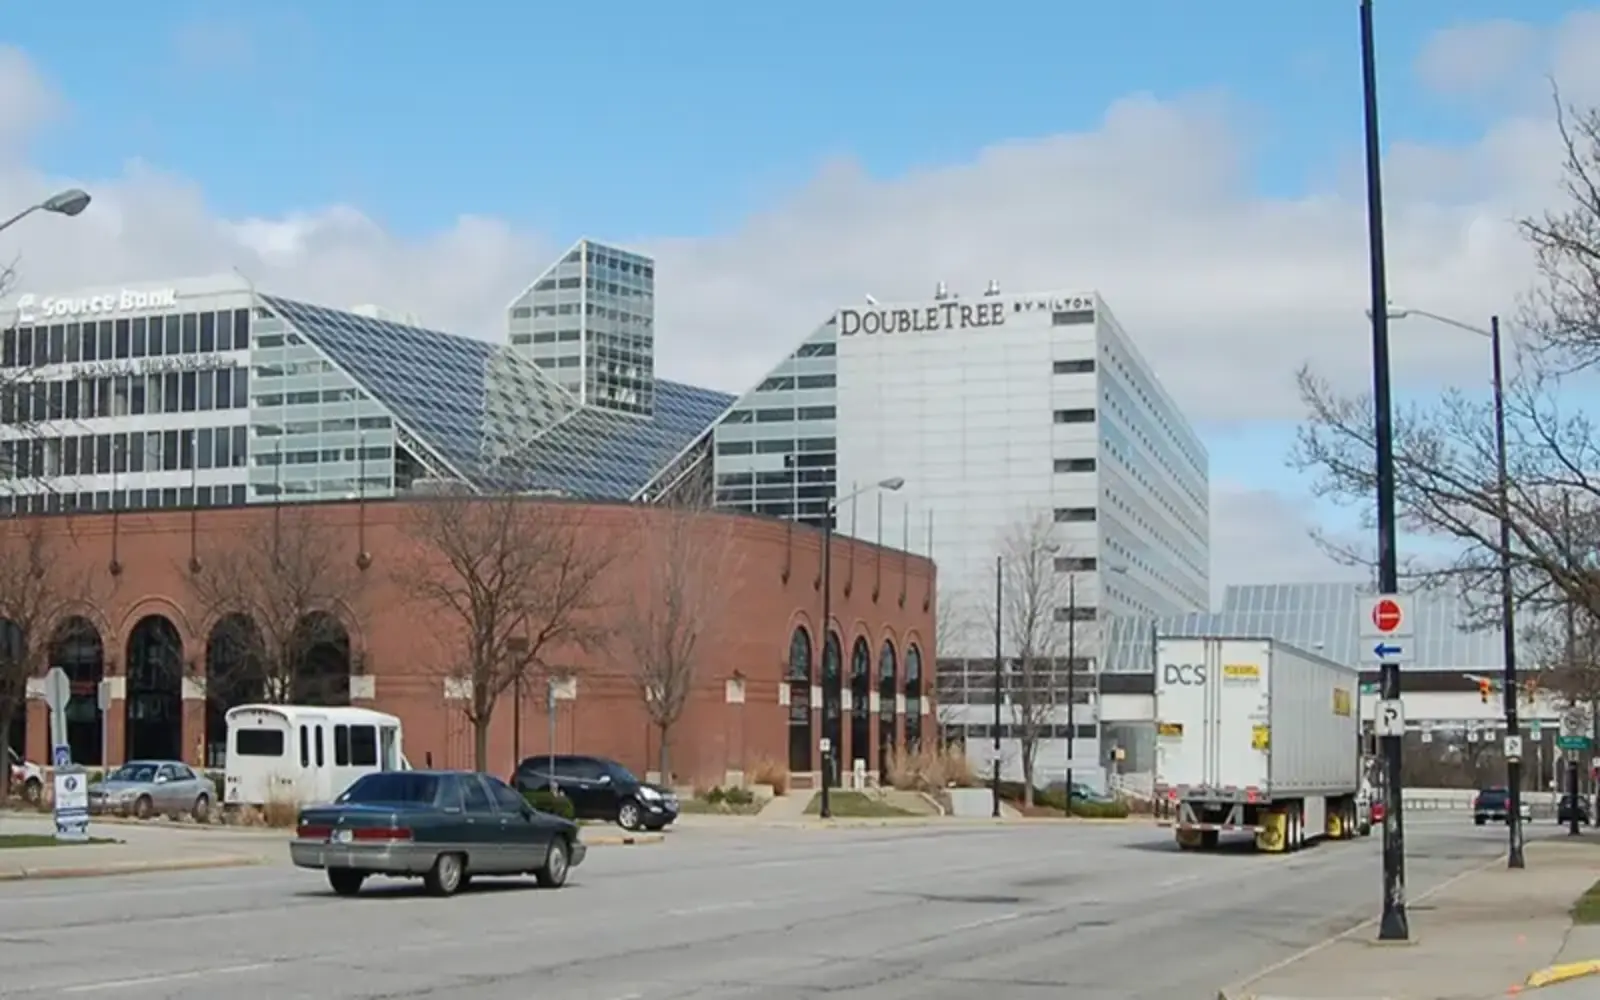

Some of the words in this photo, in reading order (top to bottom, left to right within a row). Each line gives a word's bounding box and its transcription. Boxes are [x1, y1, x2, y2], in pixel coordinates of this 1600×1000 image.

[41, 295, 115, 317] Source
[120, 288, 178, 311] Bank
[1164, 664, 1207, 686] DCS
